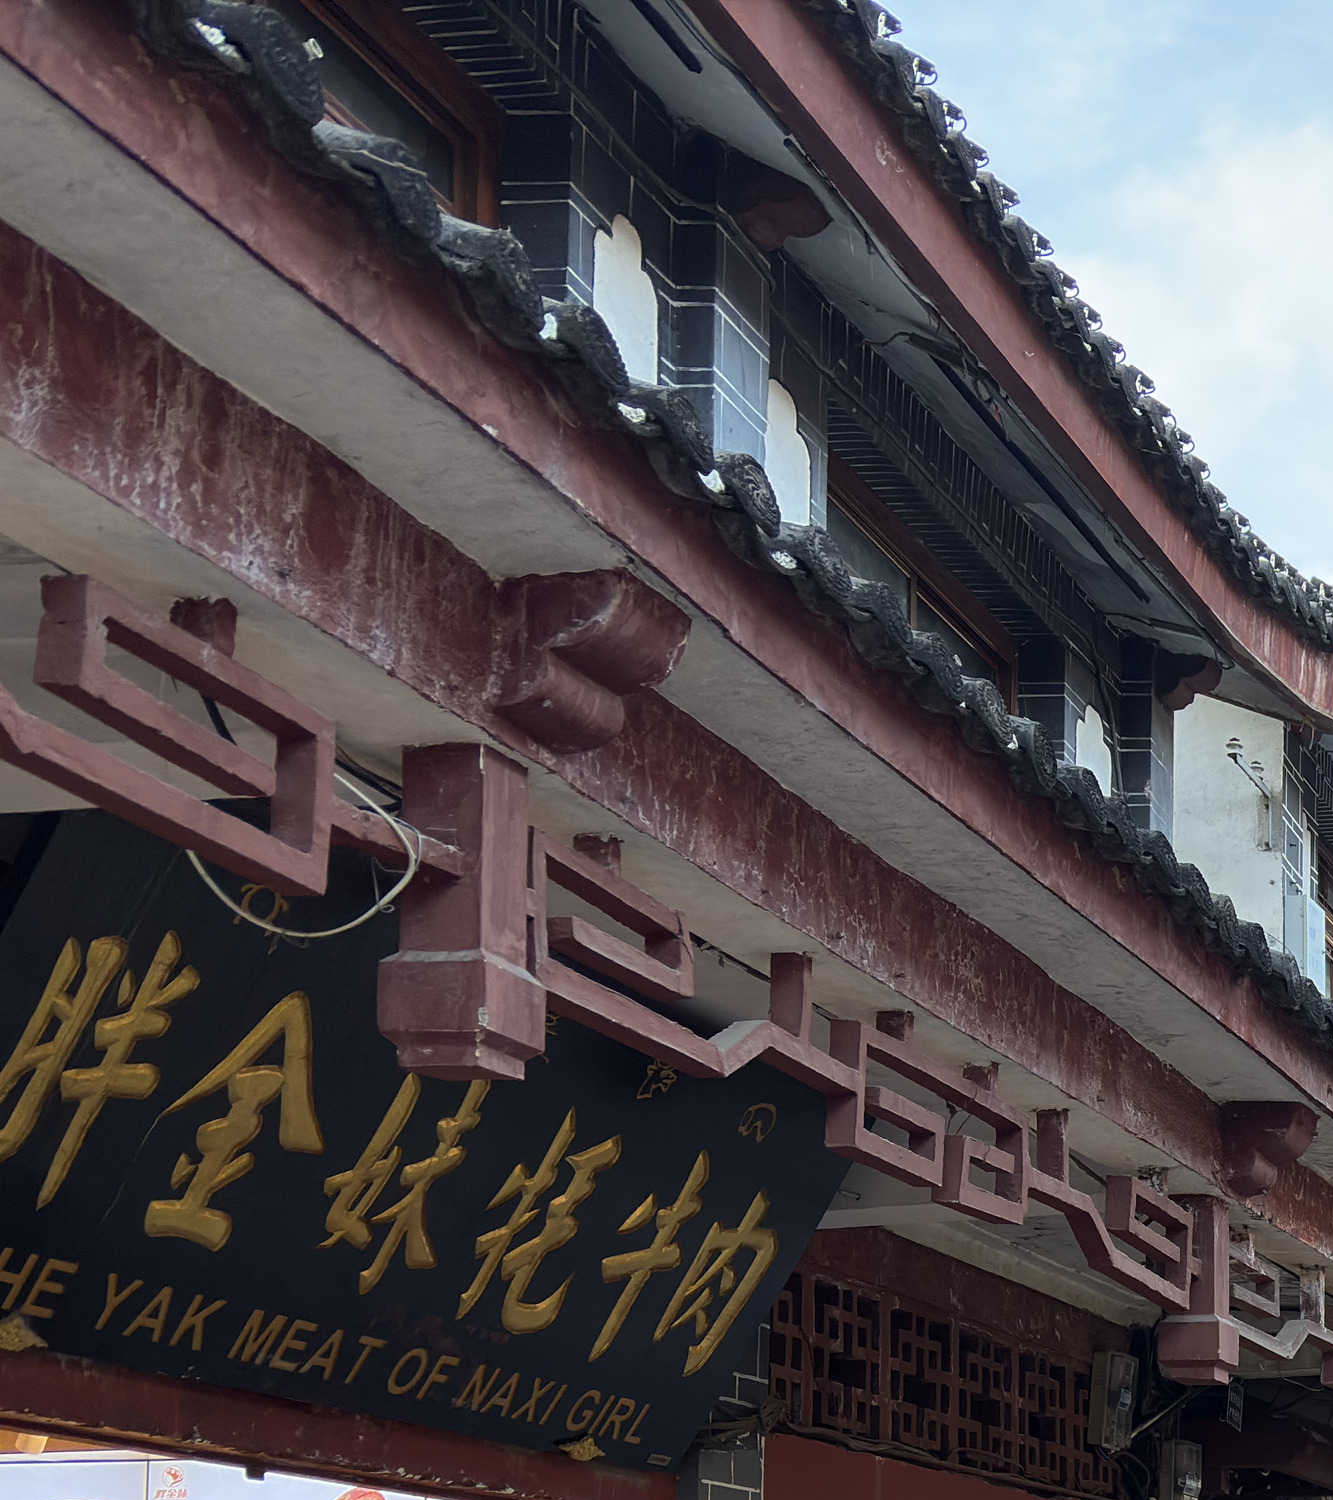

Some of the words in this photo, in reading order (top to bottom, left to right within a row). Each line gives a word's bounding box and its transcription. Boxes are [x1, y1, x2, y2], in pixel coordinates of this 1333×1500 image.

[0, 930, 779, 1378] 胖金妹牦牛肉
[0, 1247, 79, 1319] HE
[93, 1272, 227, 1352] YAK
[228, 1309, 388, 1386] MEAT
[387, 1346, 466, 1400] OF
[452, 1365, 568, 1430] NAXI
[565, 1388, 651, 1448] GIRL
